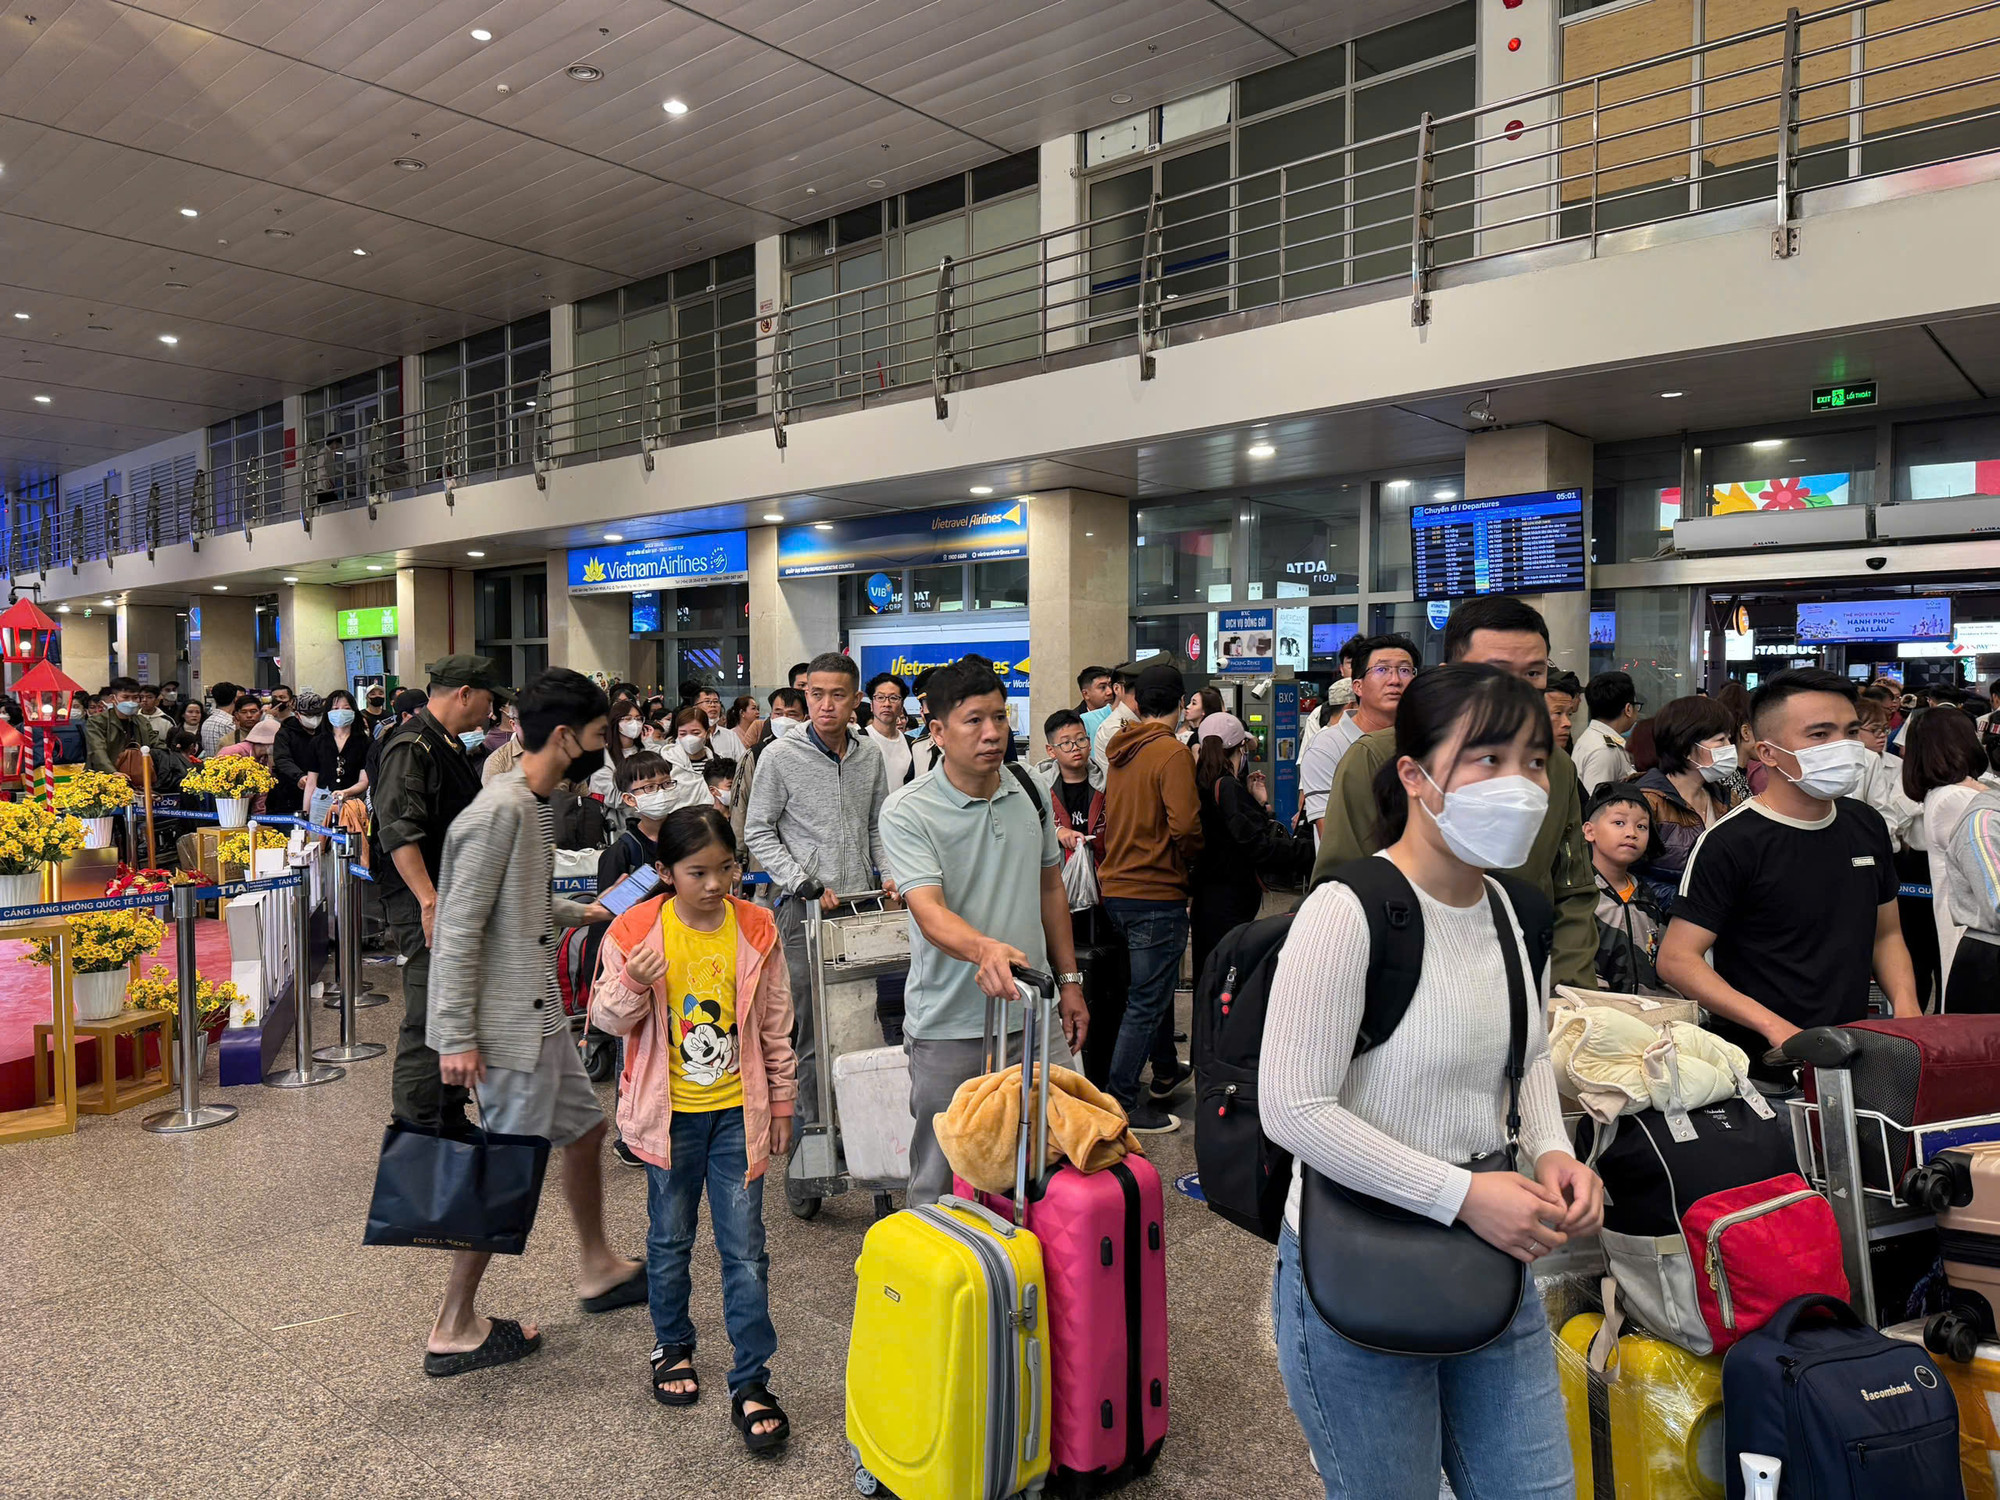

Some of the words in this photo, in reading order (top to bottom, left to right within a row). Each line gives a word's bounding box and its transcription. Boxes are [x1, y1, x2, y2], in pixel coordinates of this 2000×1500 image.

[1556, 492, 1577, 500] 05:01
[1462, 501, 1500, 511] Departures
[931, 516, 969, 530] Vietravel
[969, 513, 1003, 528] Airlines
[607, 561, 660, 580] Vietnam
[659, 555, 708, 578] Airlines
[871, 587, 887, 597] VIB
[1873, 616, 1895, 625] PHÚC
[1278, 692, 1294, 703] BXC
[217, 884, 247, 895] TIA
[553, 880, 581, 889] TIA
[4, 908, 31, 918] CẢNG
[33, 904, 59, 914] HÀNG
[62, 900, 93, 912] KHÔNG
[96, 898, 121, 911] QUỐC
[123, 896, 134, 906] TẾ
[136, 893, 152, 904] TÂN
[1860, 1381, 1913, 1401] Sacombank
